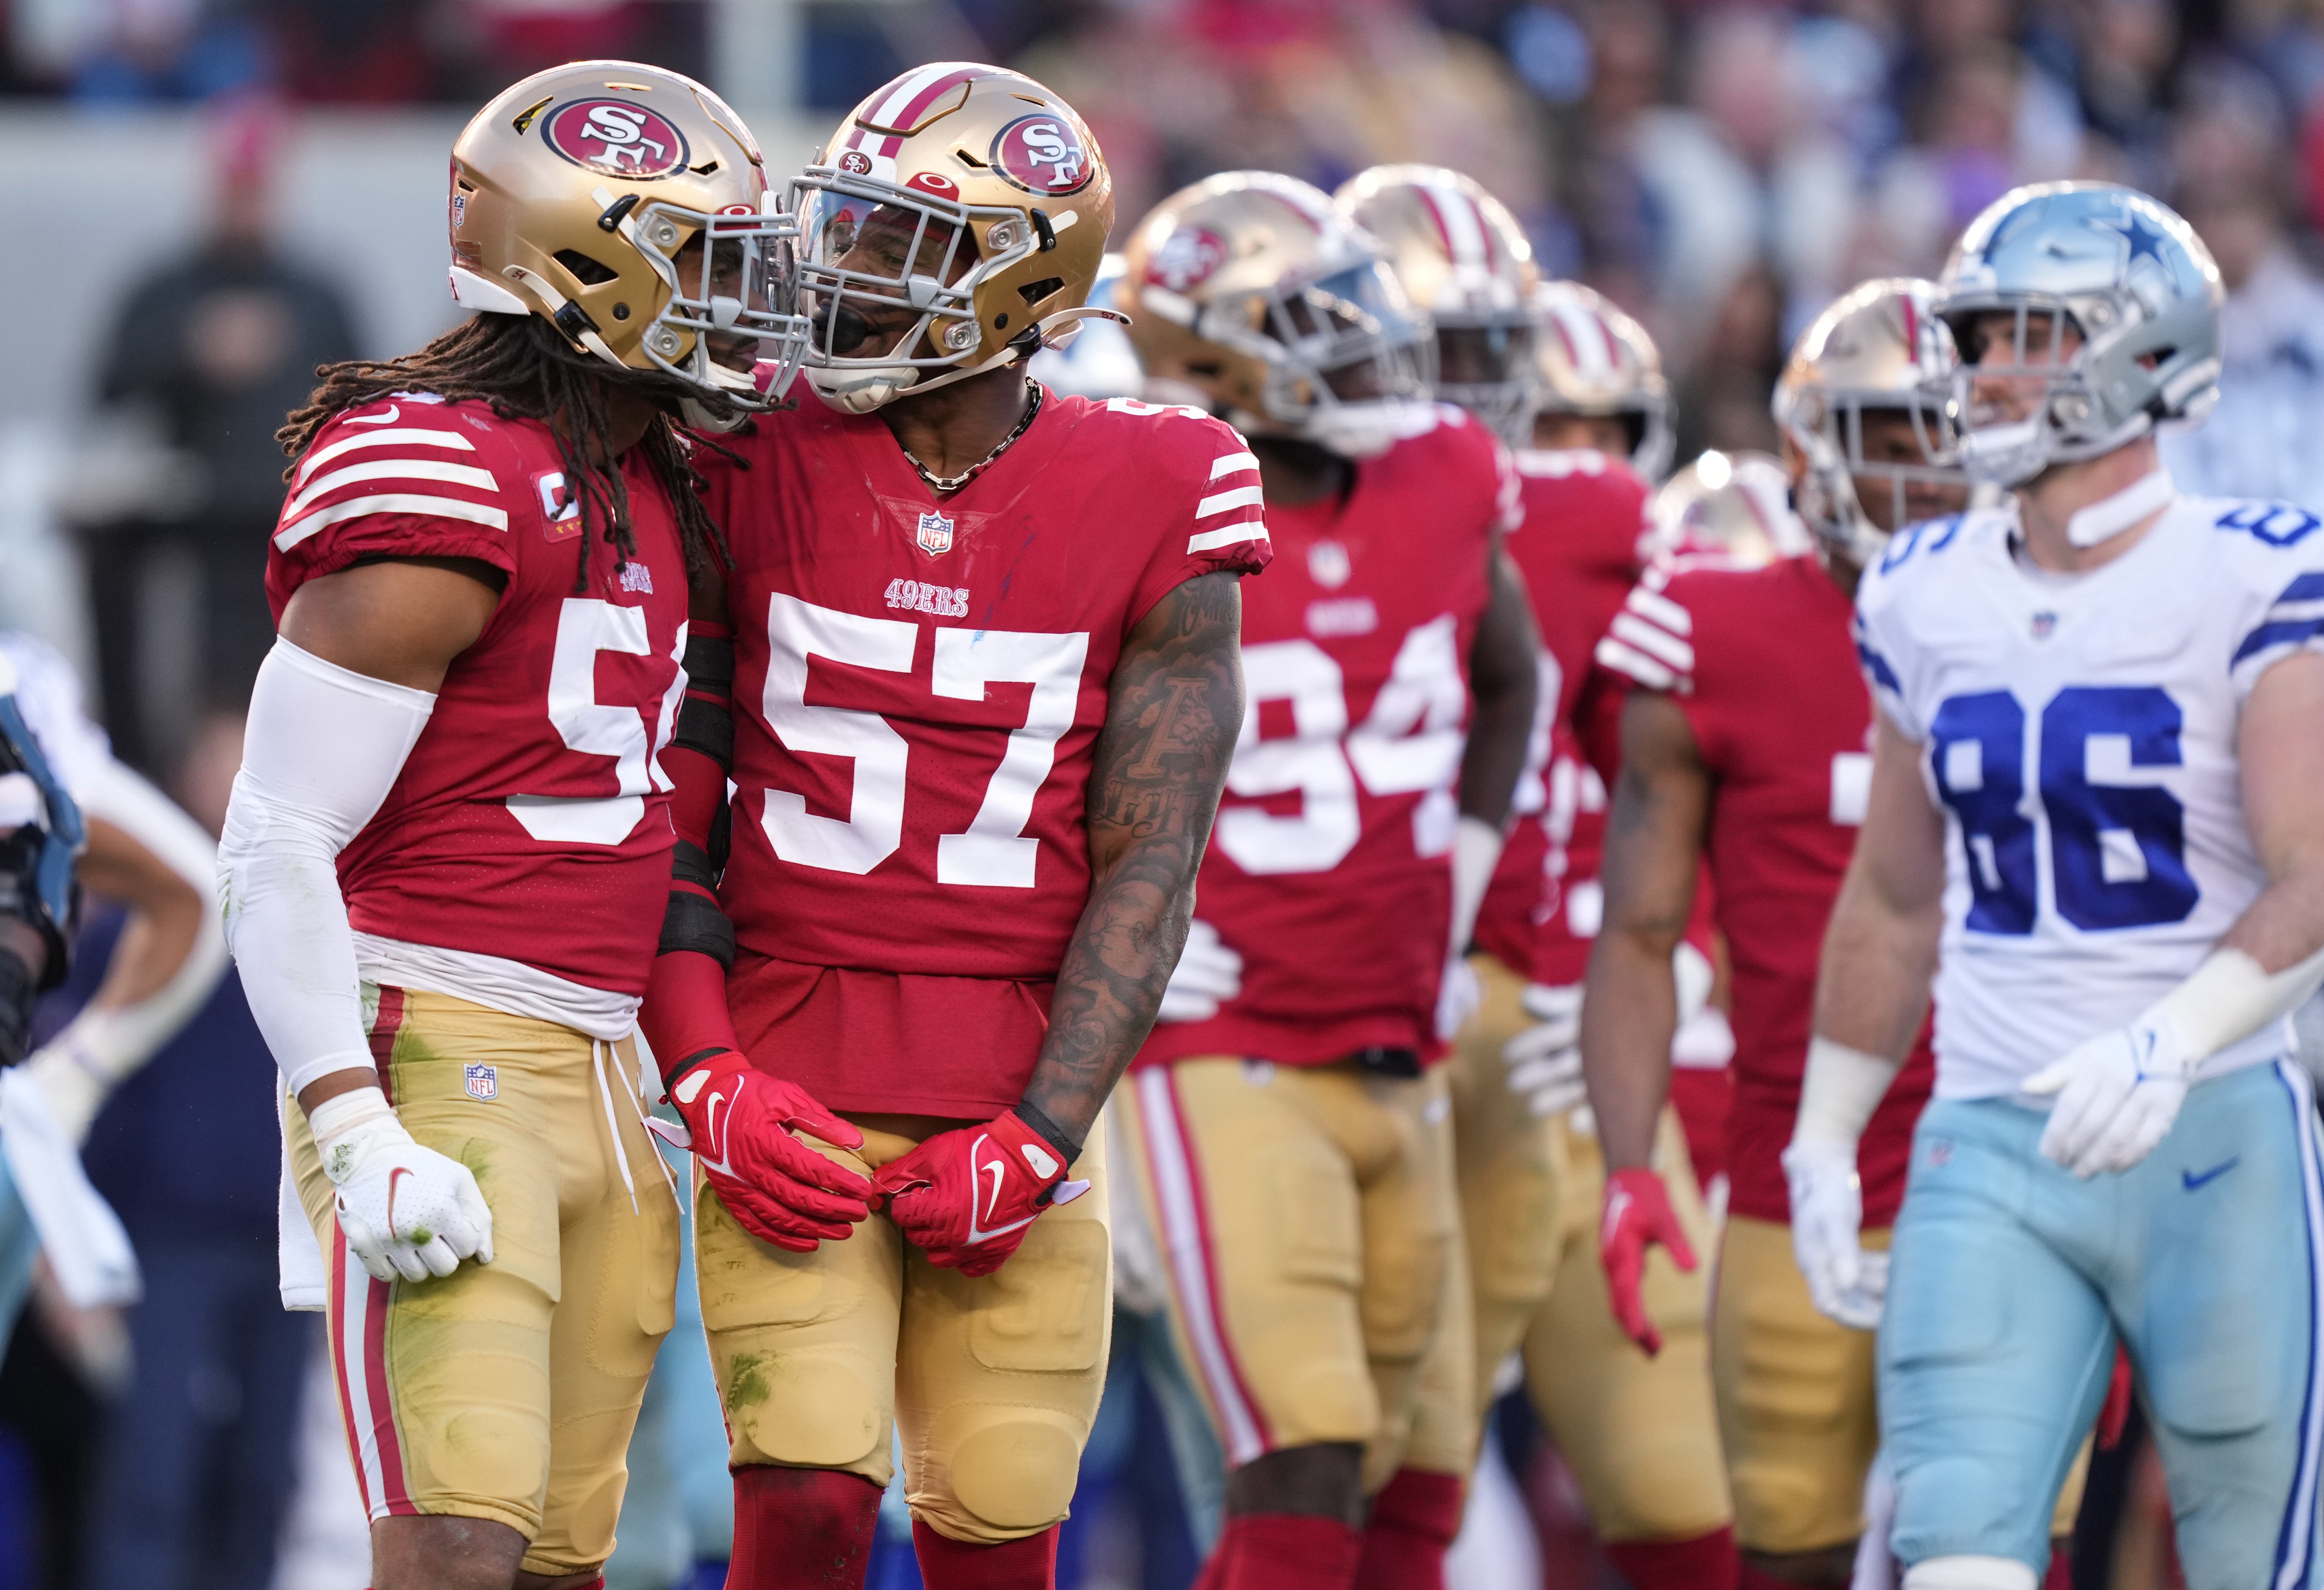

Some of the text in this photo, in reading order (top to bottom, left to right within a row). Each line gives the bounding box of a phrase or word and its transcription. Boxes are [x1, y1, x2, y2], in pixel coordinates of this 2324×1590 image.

[581, 105, 665, 169] SF
[1022, 122, 1084, 187] SF
[512, 270, 527, 280] 54
[1101, 311, 1116, 320] 57
[923, 529, 947, 548] NFL
[884, 578, 969, 618] 49ERS
[761, 592, 1090, 888] 57
[1214, 612, 1466, 875] 94
[1930, 686, 2201, 935] 86
[470, 1079, 493, 1095] NFL
